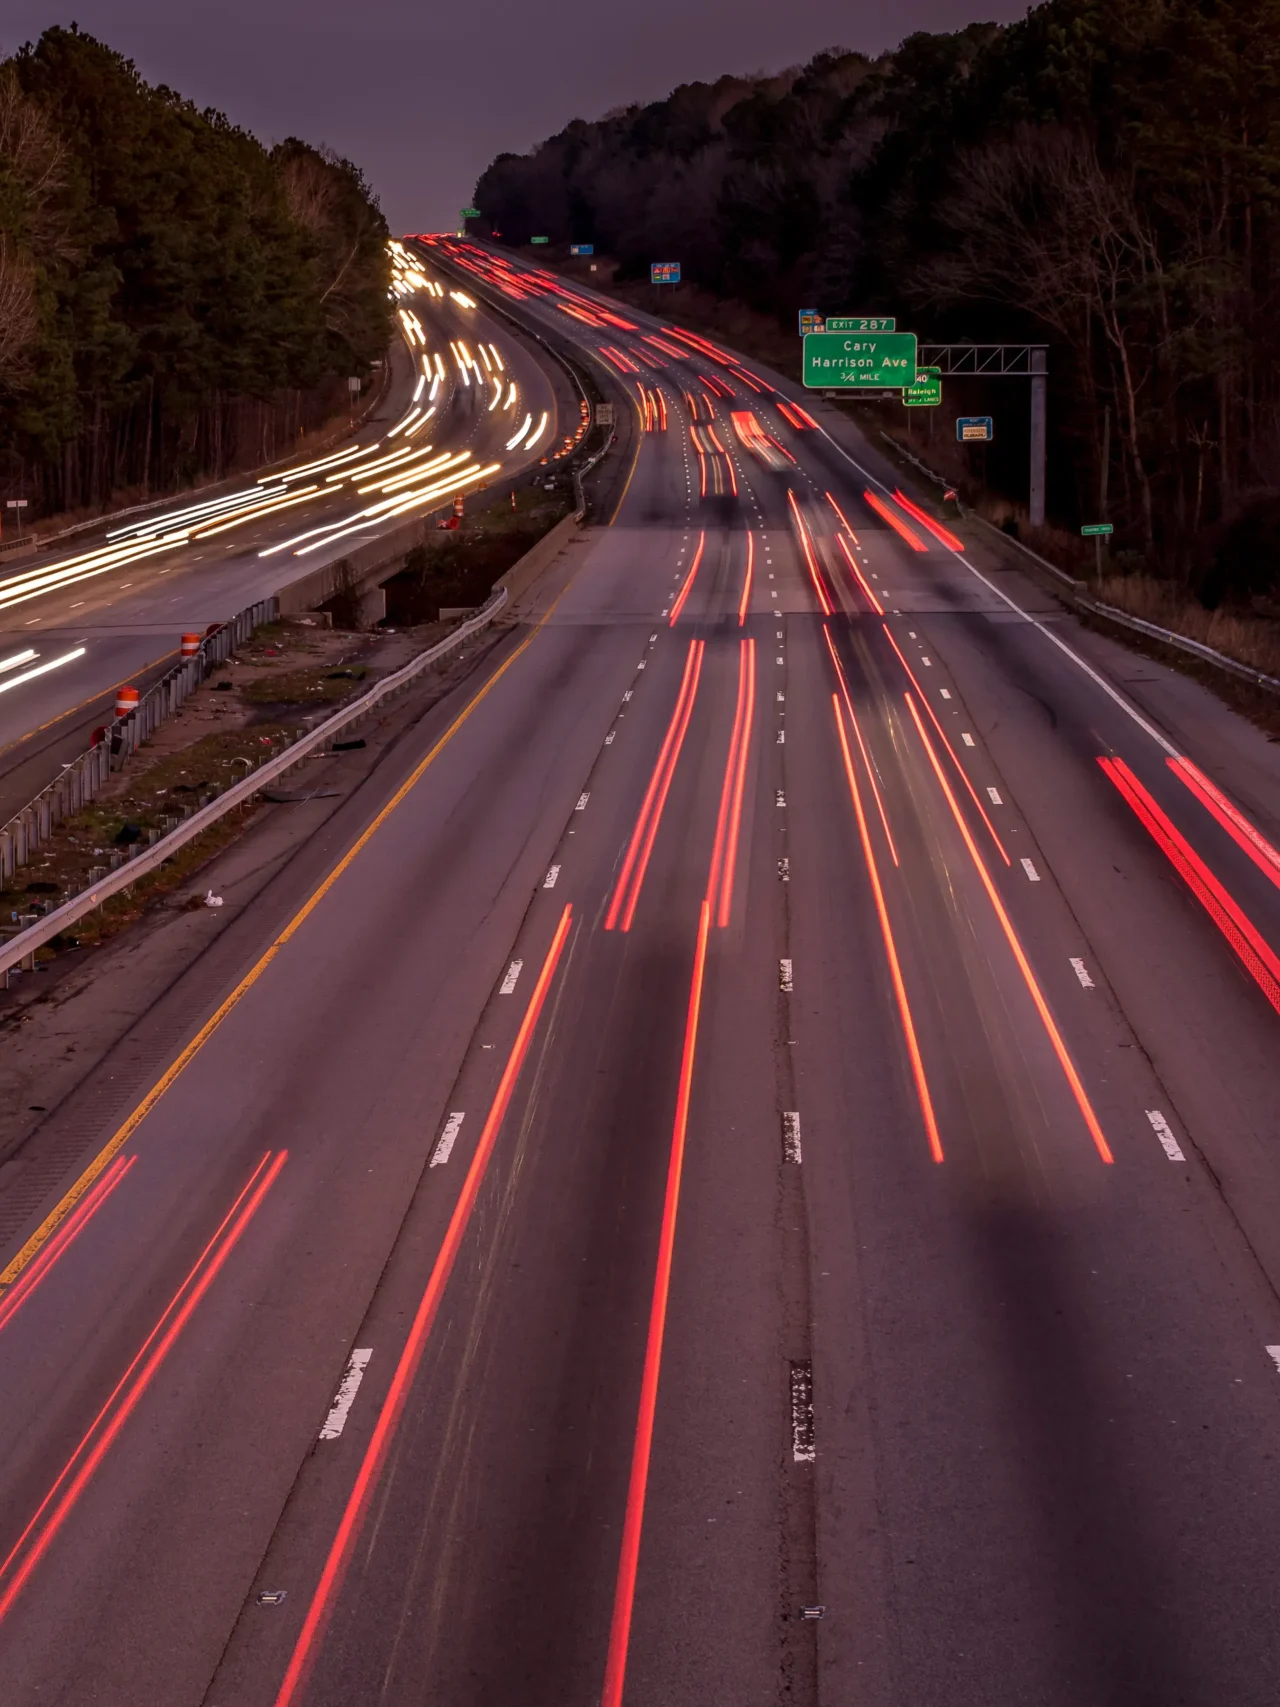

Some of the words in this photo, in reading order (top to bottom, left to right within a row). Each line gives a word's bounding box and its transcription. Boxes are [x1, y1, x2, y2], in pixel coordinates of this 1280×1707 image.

[832, 321, 853, 329] EXIT
[860, 320, 887, 330] 287
[844, 341, 876, 353] Cary
[812, 357, 873, 367] Harrison
[882, 357, 908, 367] Ave
